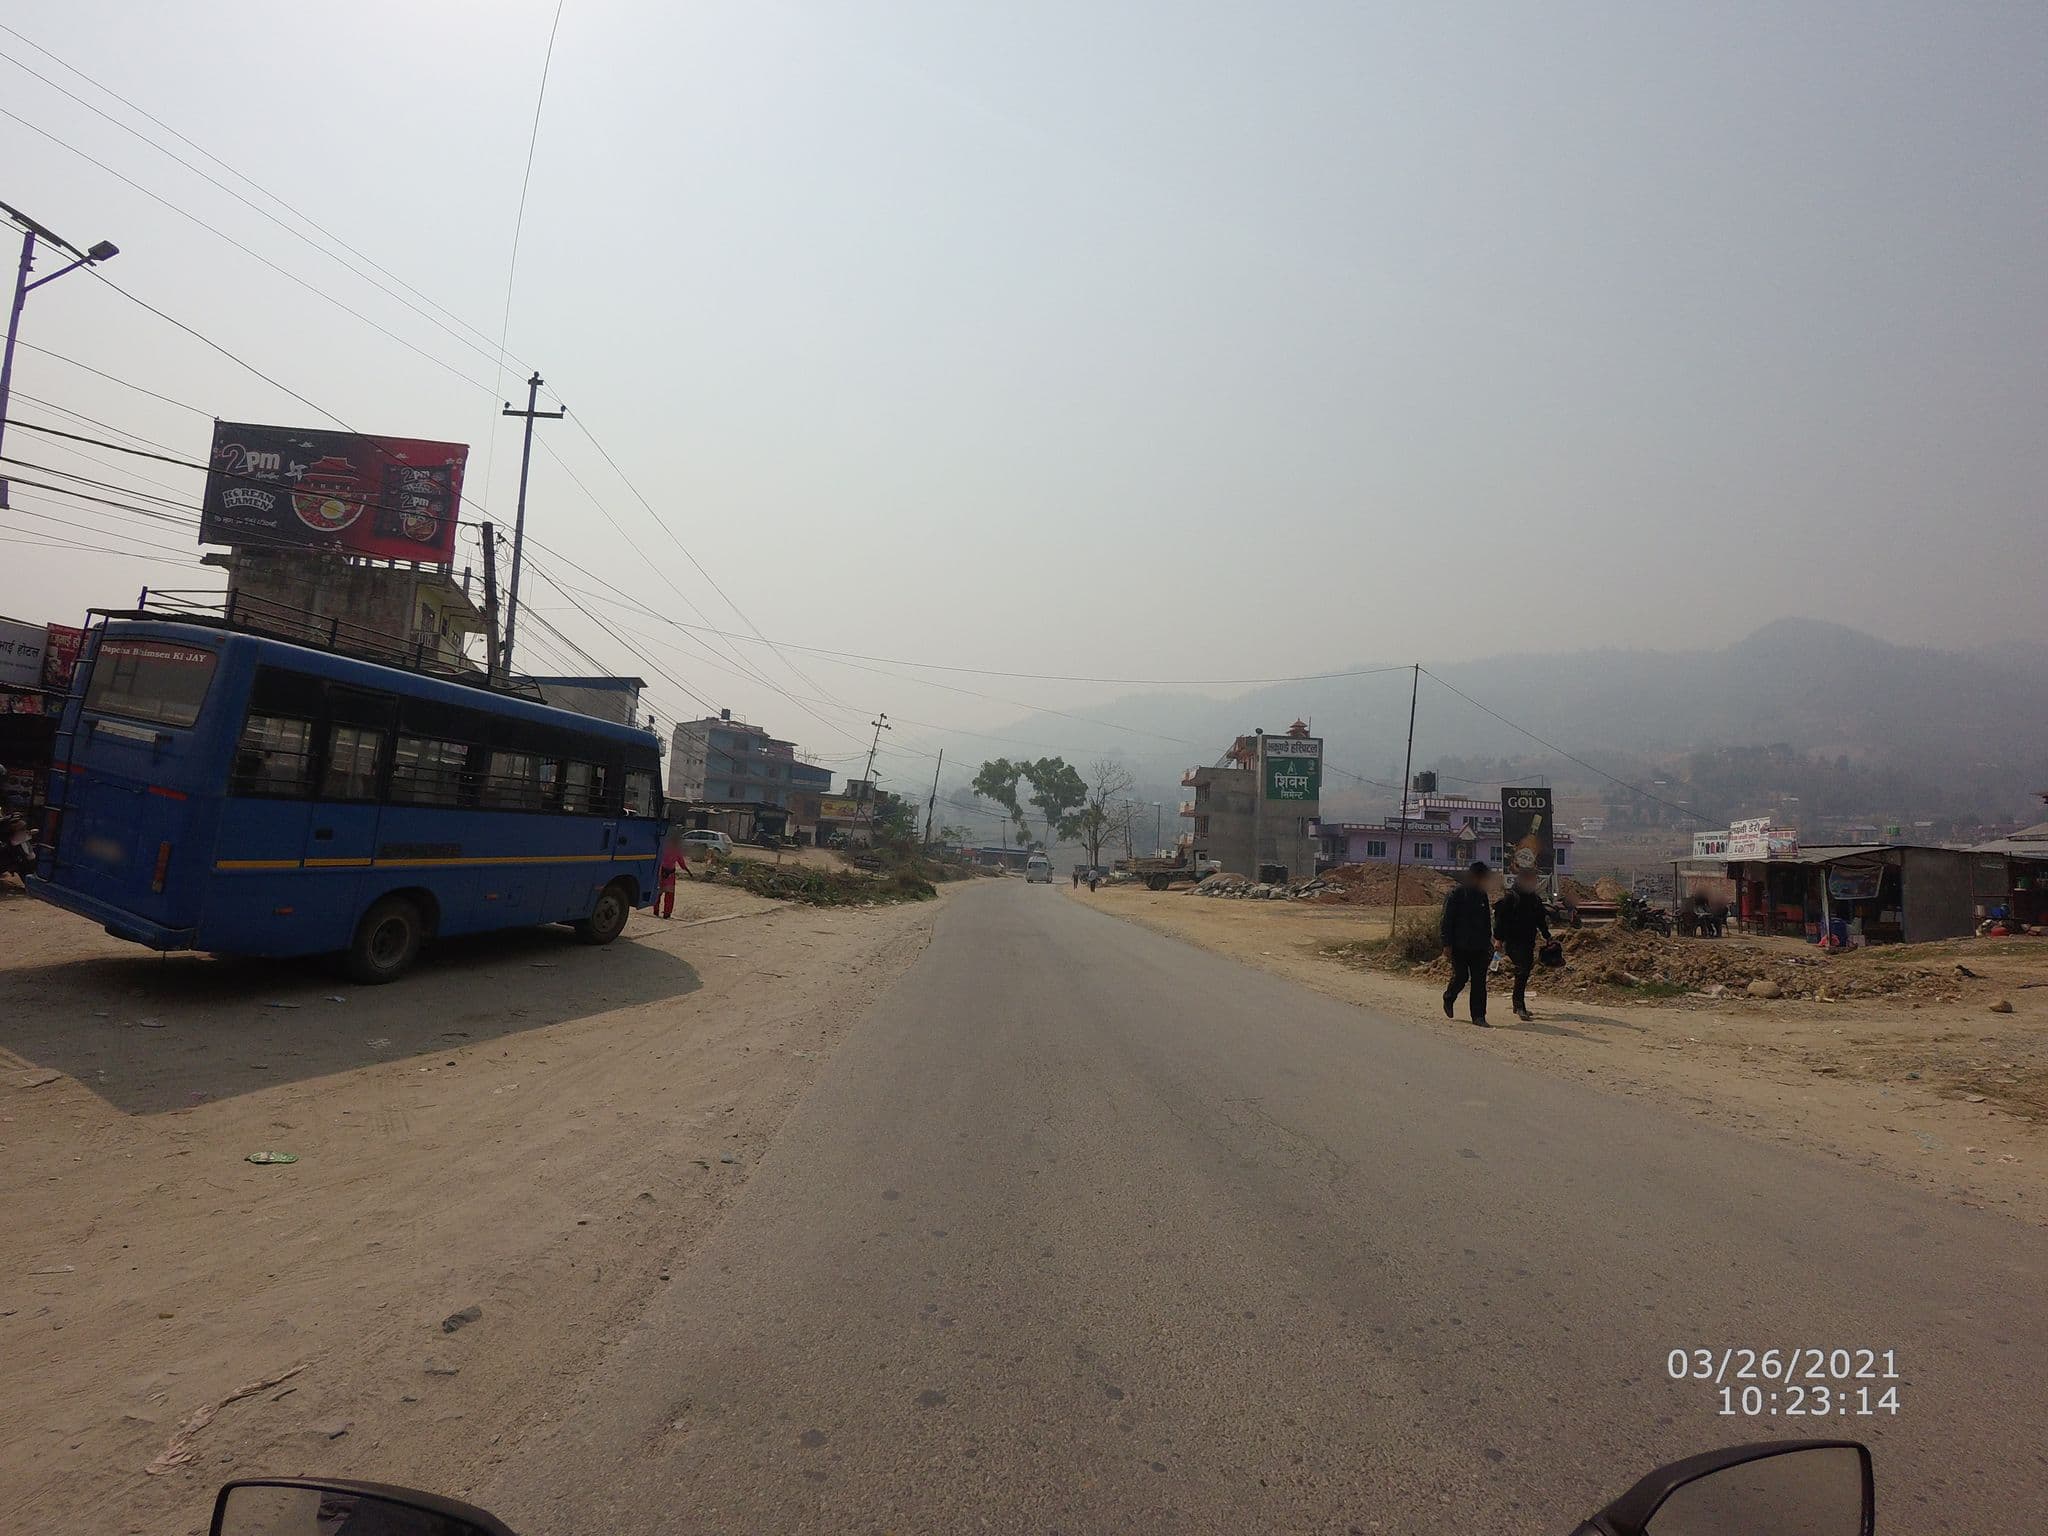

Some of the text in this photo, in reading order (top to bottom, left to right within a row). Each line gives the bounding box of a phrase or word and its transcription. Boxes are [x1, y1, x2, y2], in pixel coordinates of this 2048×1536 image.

[221, 443, 281, 476] 2pm
[222, 487, 276, 504] KOREAN
[224, 497, 274, 511] RAMEN
[17, 642, 41, 657] होटल
[185, 653, 208, 662] JAY
[1274, 772, 1309, 793] शिवम्
[1507, 796, 1546, 809] GOLD
